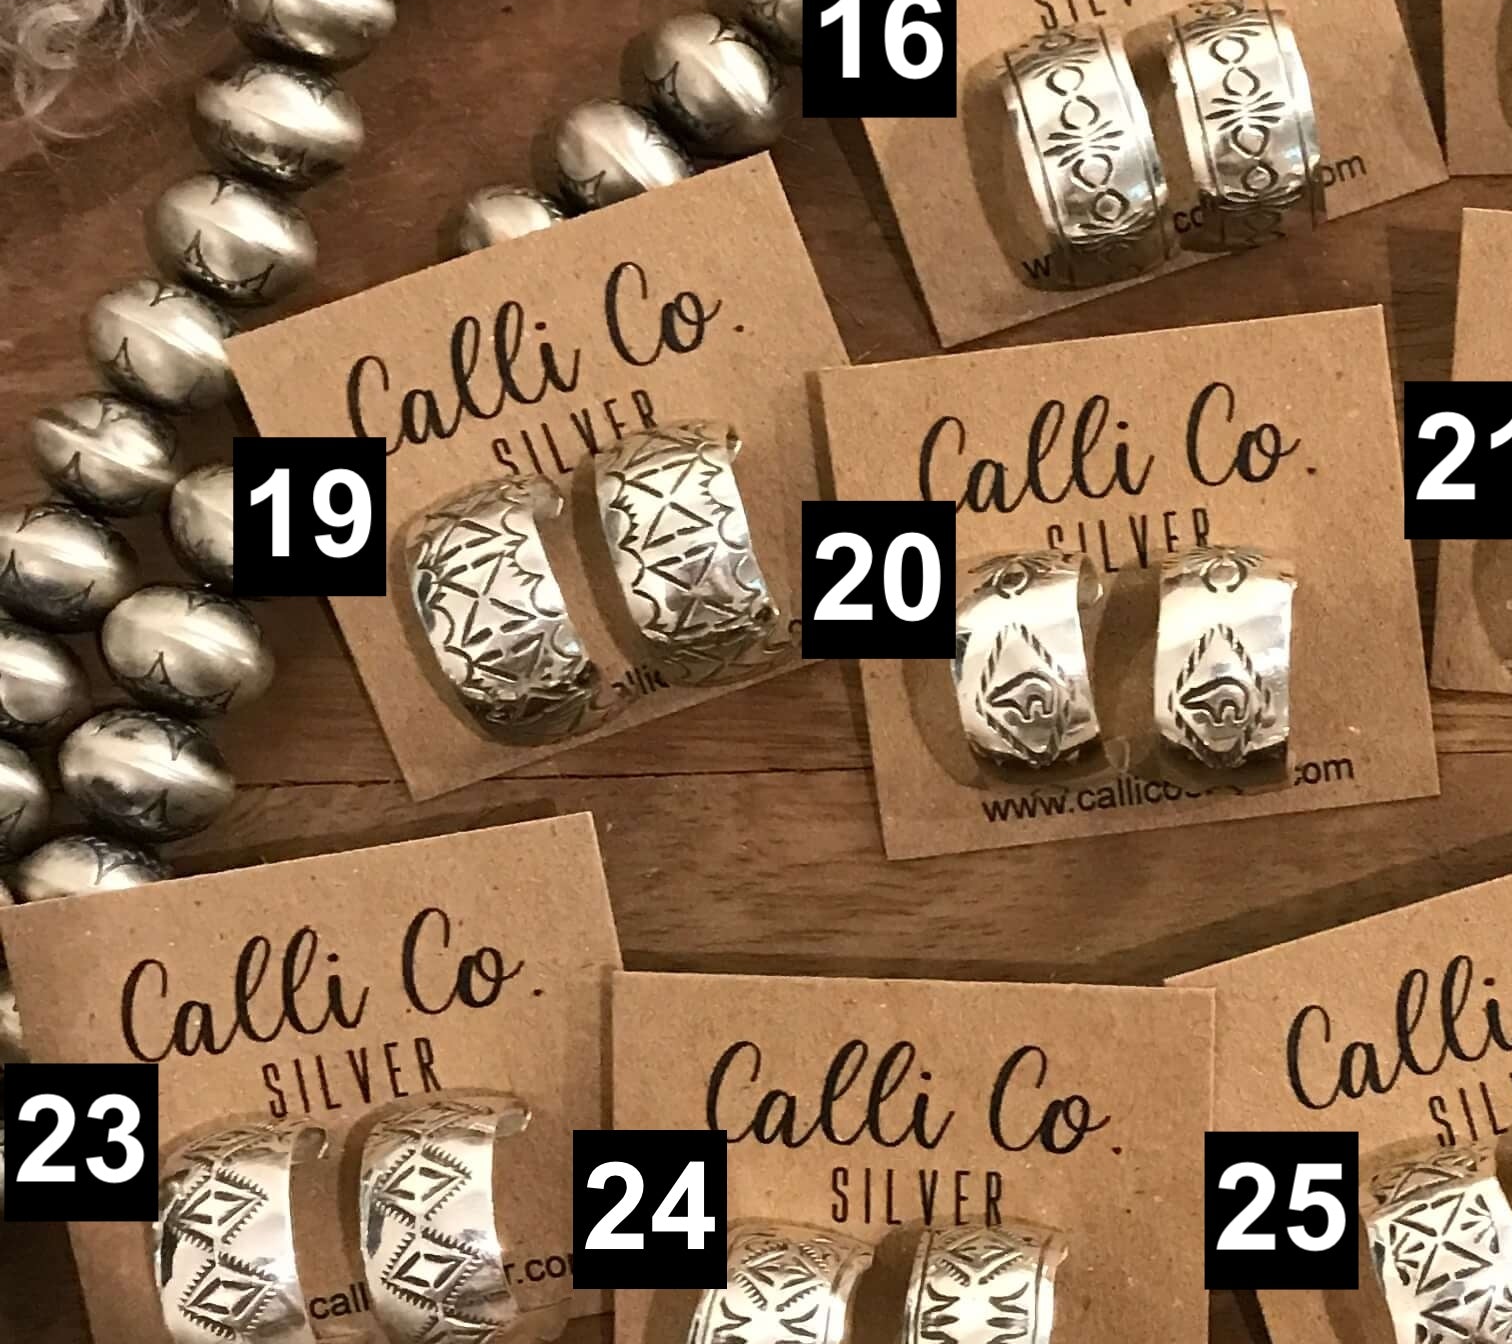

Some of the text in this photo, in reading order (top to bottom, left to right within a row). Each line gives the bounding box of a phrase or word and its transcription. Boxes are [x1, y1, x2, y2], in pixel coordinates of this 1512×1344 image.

[347, 261, 745, 457] Calli Co.
[492, 390, 657, 475] SILVER
[919, 382, 1317, 514] Calli Co.
[121, 907, 543, 1063] Calli Co.
[263, 1037, 443, 1118] SILVER
[705, 1039, 1122, 1156] Calli Co.
[831, 1167, 1002, 1227] SILVER
